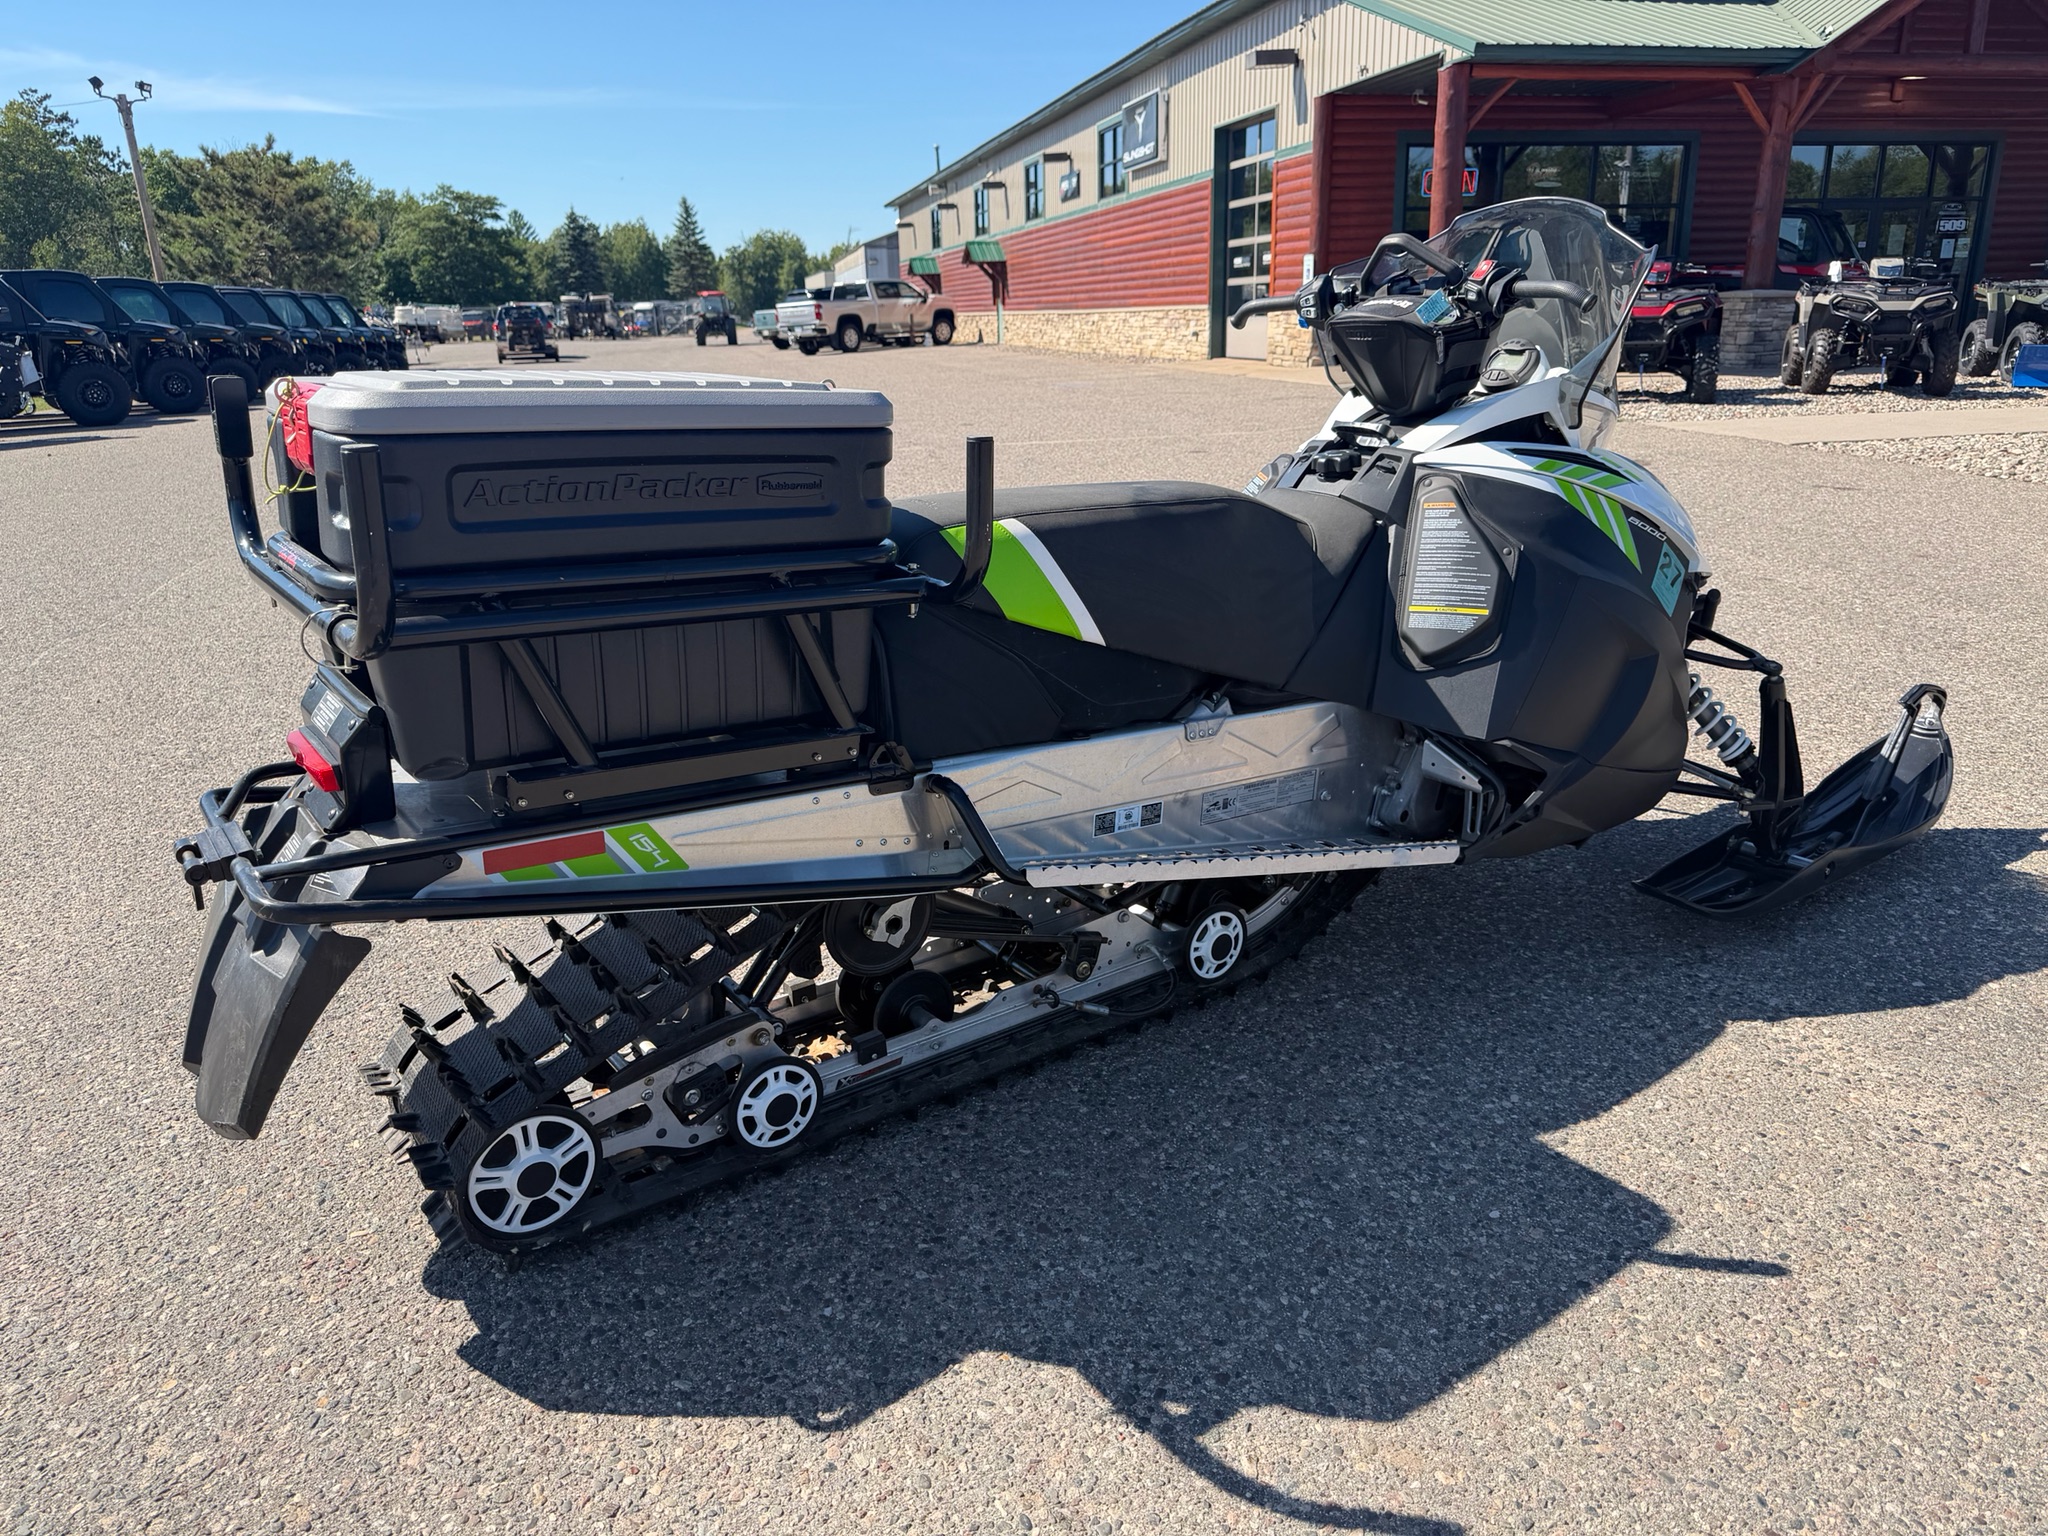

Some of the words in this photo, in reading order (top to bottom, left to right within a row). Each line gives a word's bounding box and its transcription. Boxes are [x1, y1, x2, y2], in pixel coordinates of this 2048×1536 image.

[1423, 170, 1476, 194] ON
[1939, 219, 1966, 231] 509
[463, 472, 749, 507] ActionPacker
[761, 480, 823, 491] Rubbermaid
[1660, 552, 1682, 588] 27
[629, 833, 670, 868] 154
